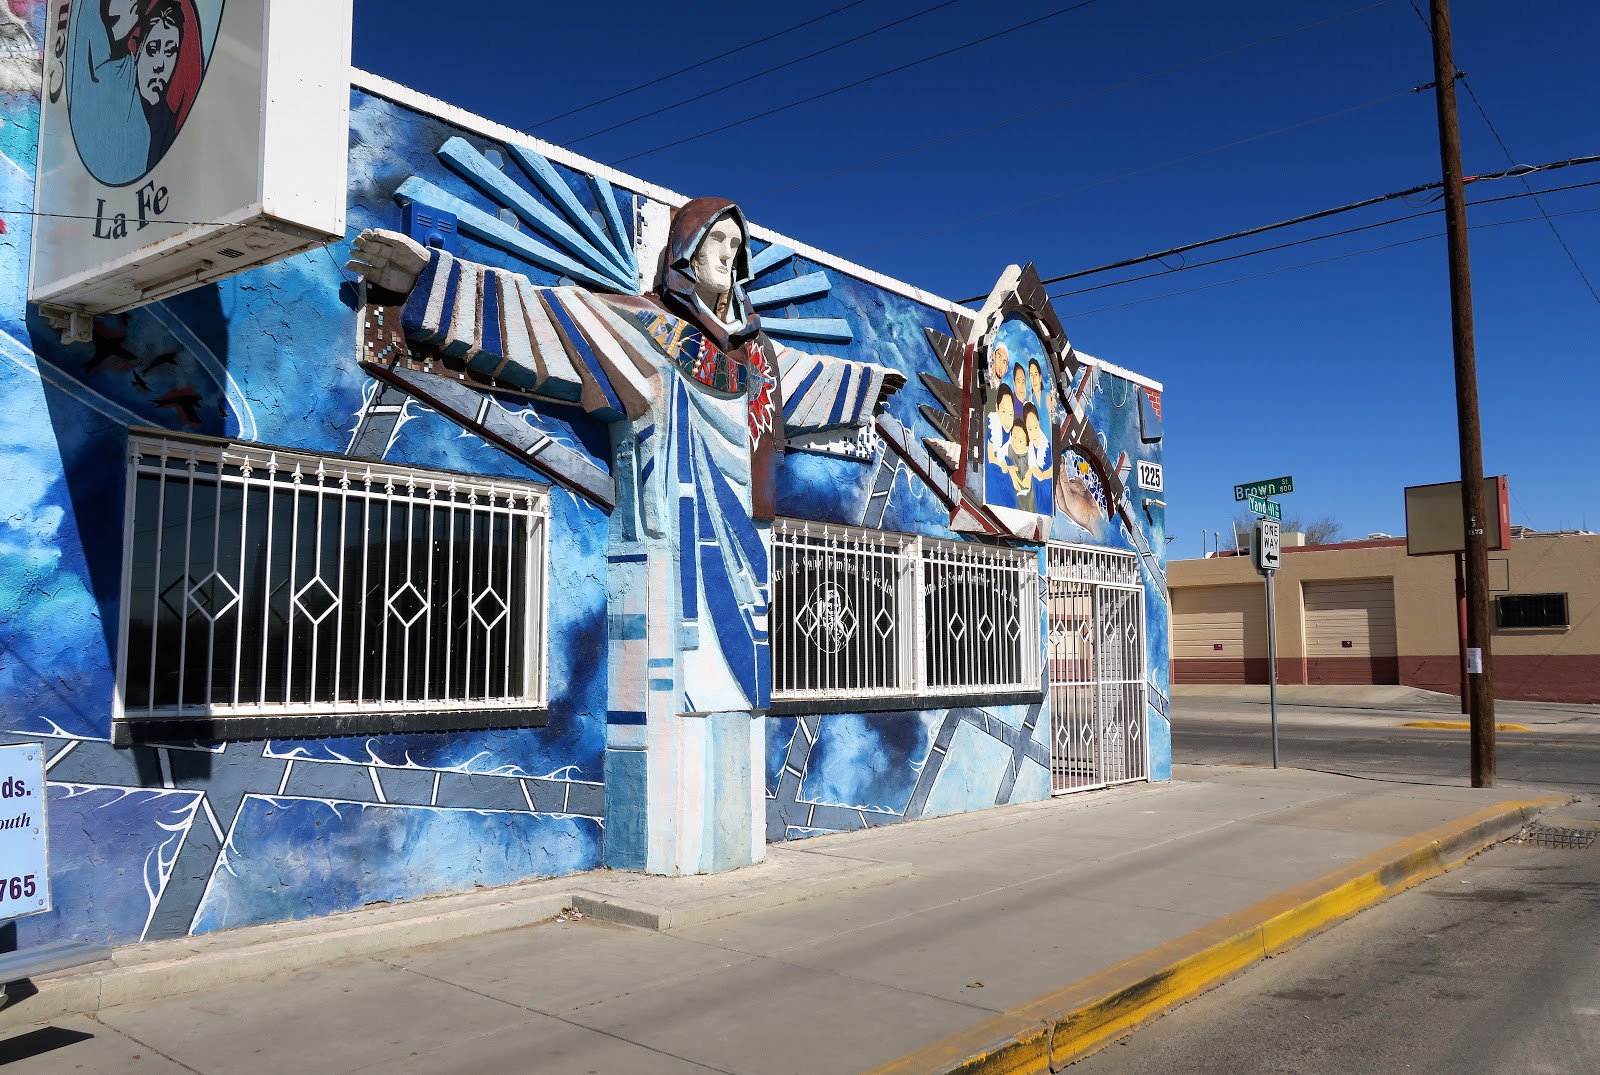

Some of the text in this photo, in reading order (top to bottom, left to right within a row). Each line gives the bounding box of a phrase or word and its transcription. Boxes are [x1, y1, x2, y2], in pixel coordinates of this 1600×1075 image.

[92, 180, 169, 240] La Fe
[1139, 464, 1161, 488] 1225
[1235, 483, 1276, 500] Brown
[1264, 524, 1278, 537] ONE
[1264, 537, 1278, 550] WAY
[827, 555, 857, 576] Fmiliar
[0, 874, 36, 902] 765
